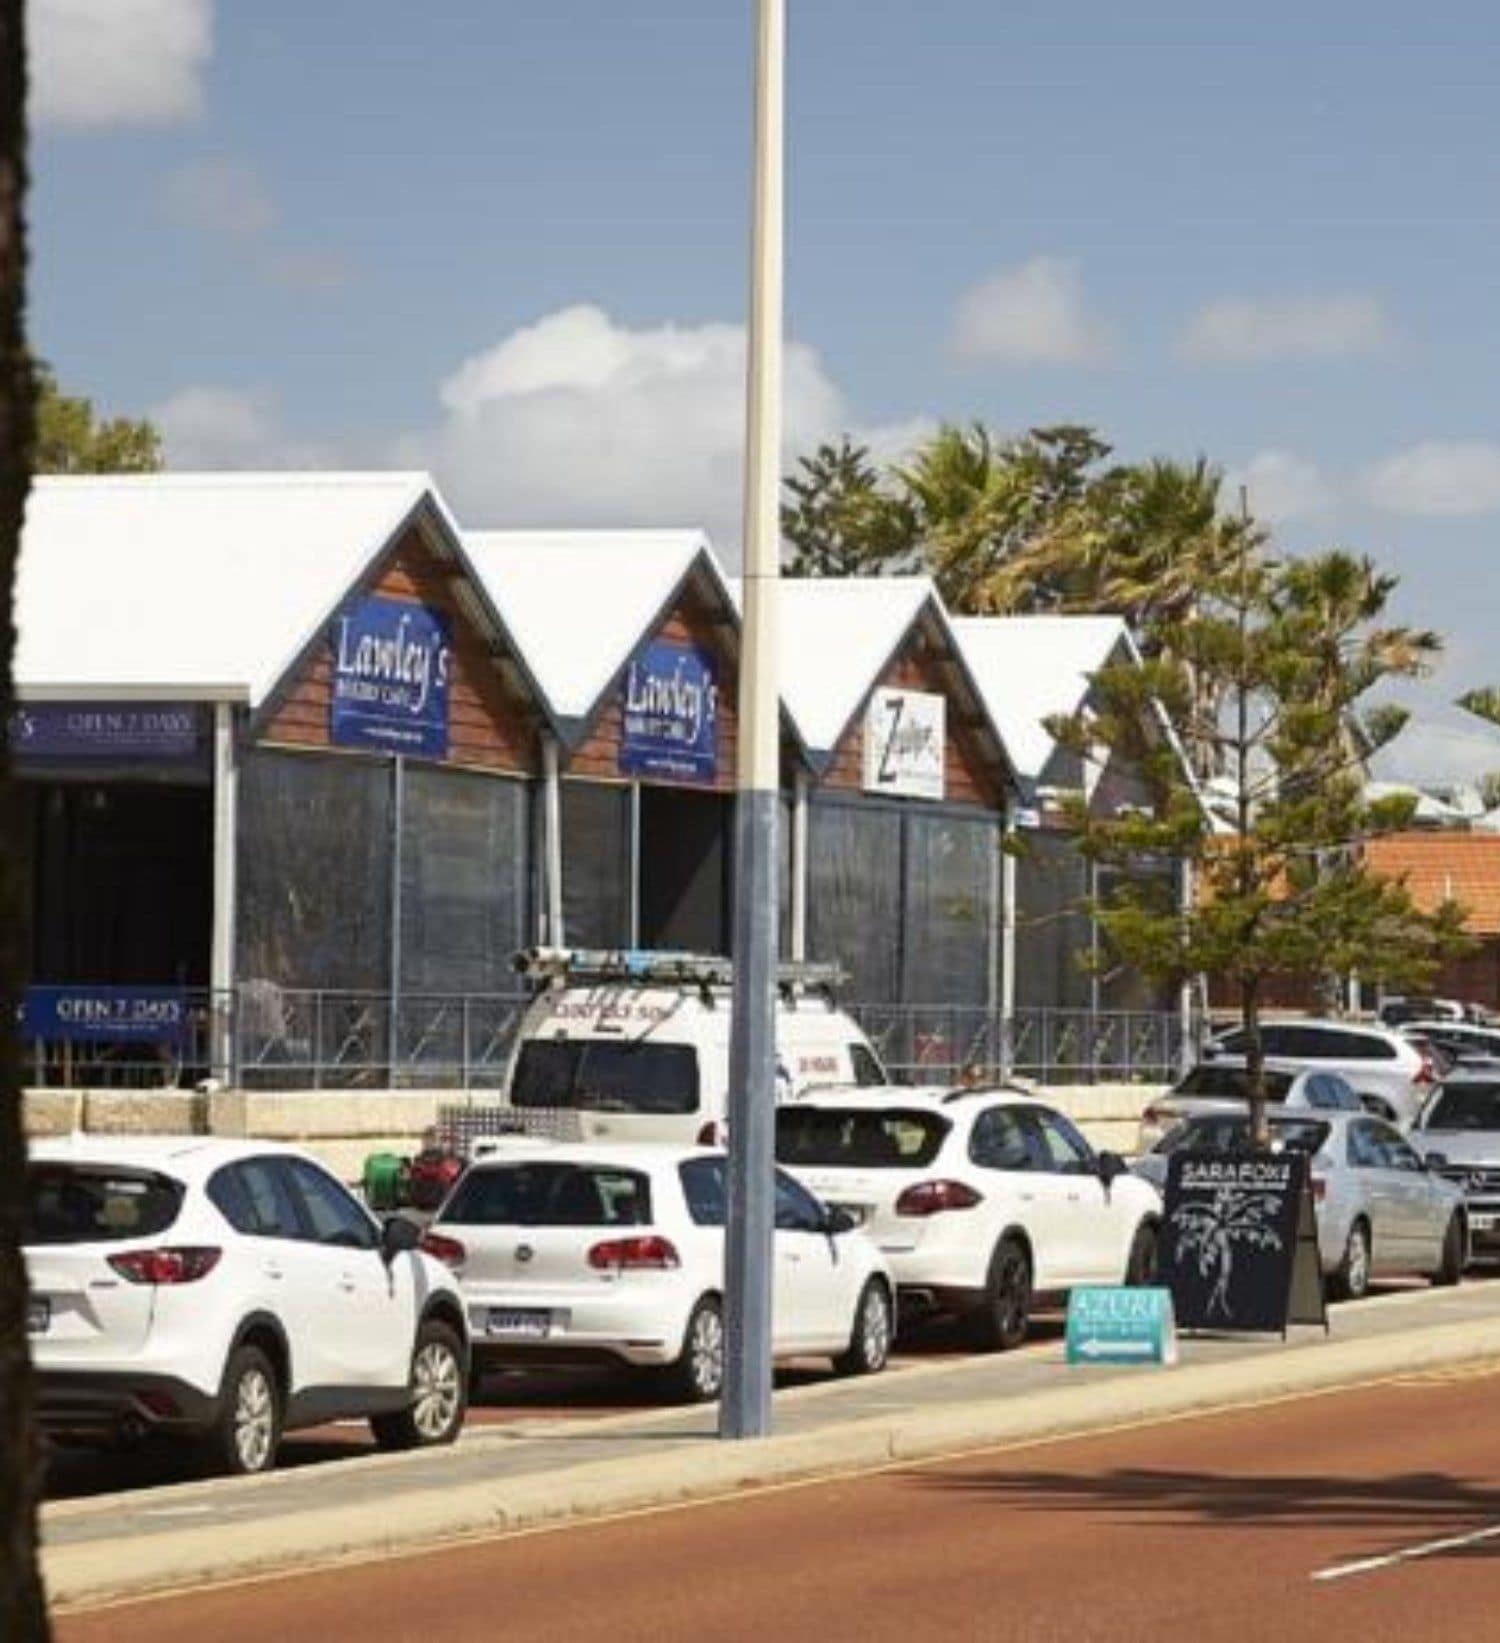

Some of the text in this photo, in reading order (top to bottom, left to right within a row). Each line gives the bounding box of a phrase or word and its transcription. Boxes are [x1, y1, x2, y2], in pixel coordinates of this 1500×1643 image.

[337, 613, 448, 714] Lawley's
[56, 999, 180, 1022] OPEN 7 DAYS
